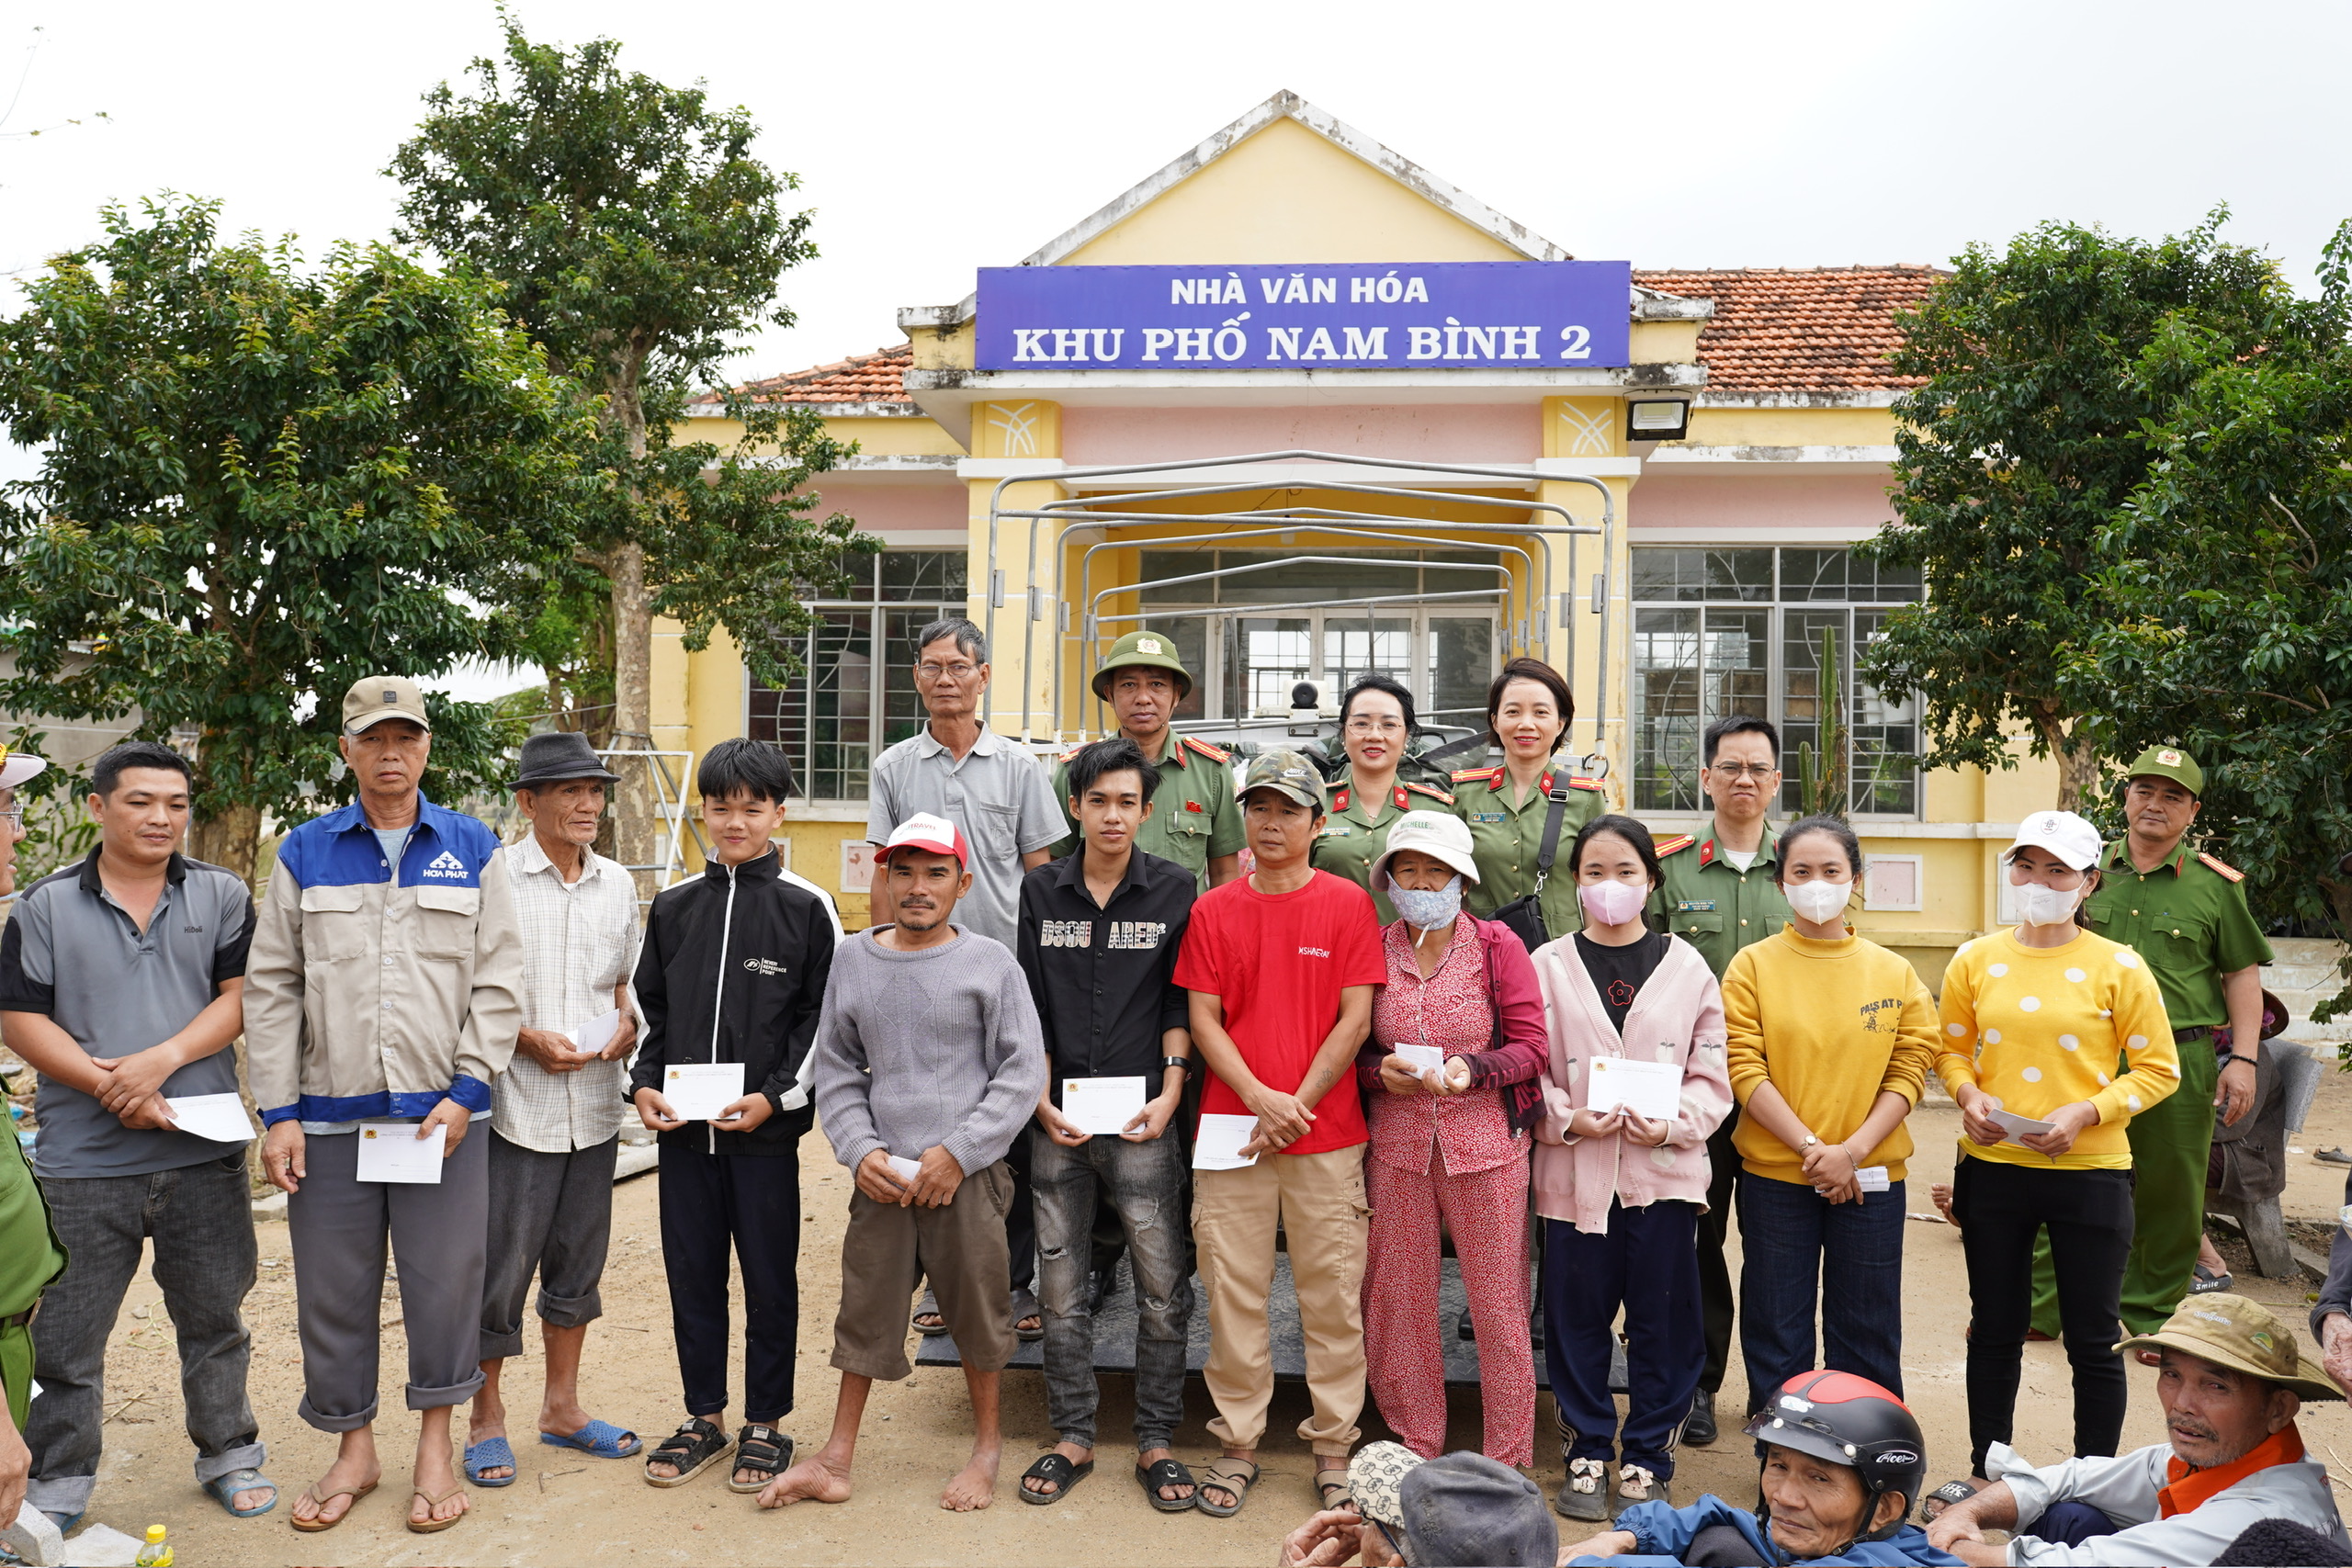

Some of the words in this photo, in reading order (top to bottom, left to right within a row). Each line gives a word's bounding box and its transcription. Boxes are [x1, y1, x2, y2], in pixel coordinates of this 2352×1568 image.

[1171, 272, 1247, 305] NHÀ
[1260, 273, 1337, 304] VĂN
[1351, 270, 1429, 303] HÓA
[1012, 328, 1125, 362] KHU
[1141, 311, 1251, 361] PHỐ
[1266, 327, 1389, 360] NAM
[1407, 316, 1542, 360] BÌNH
[1560, 325, 1591, 359] 2
